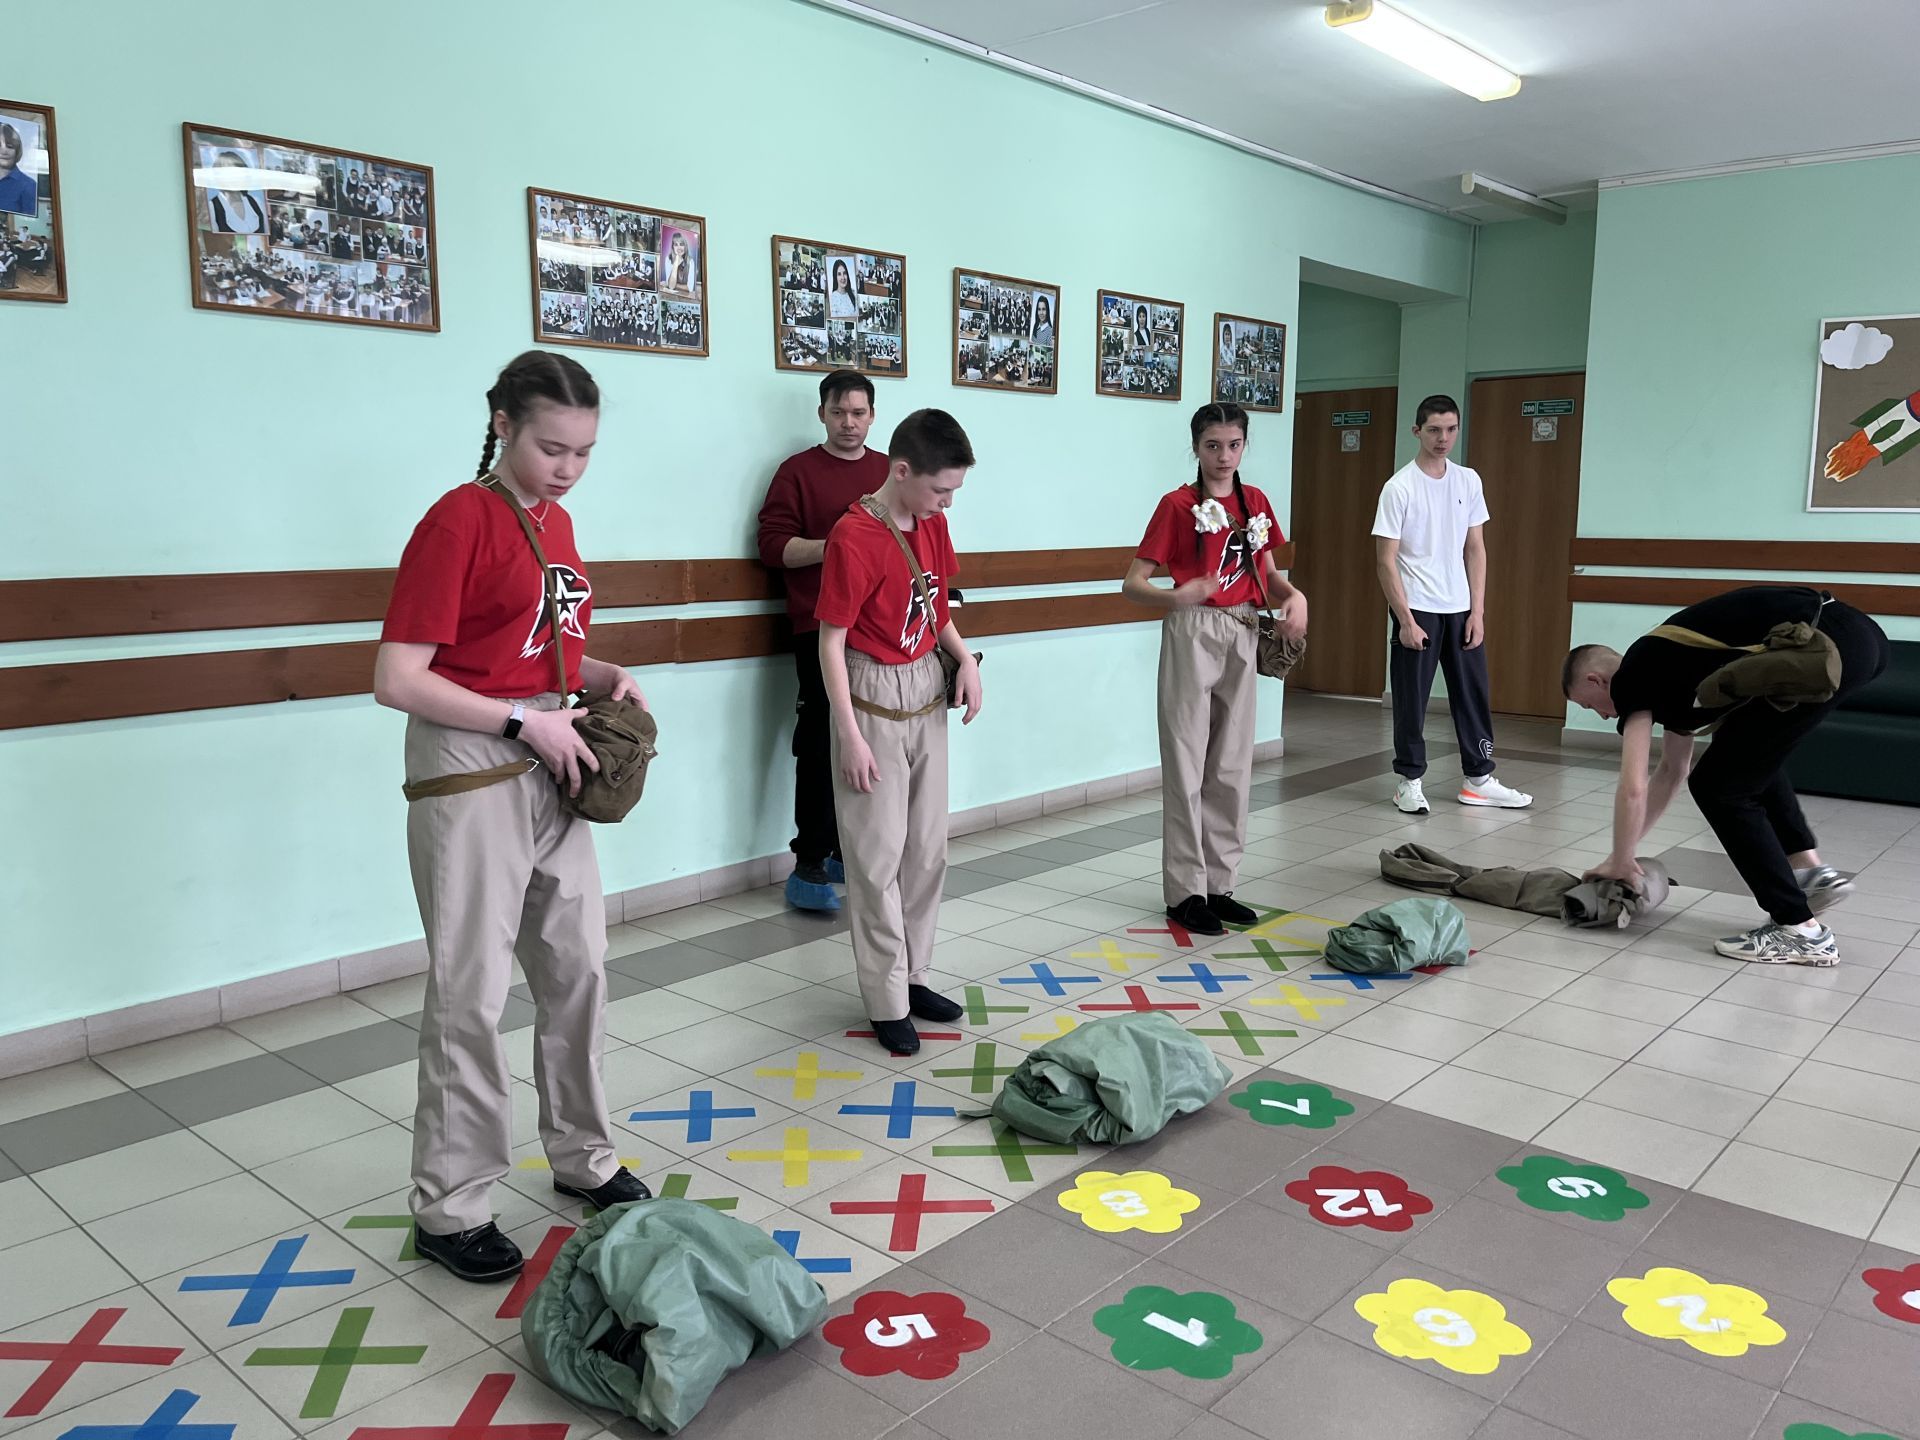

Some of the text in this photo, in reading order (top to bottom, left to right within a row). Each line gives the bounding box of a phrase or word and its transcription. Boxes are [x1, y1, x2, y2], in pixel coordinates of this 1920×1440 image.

[1260, 1097, 1311, 1116] 7
[1098, 1189, 1150, 1219] 8
[1315, 1189, 1403, 1219] 12
[1143, 1311, 1210, 1348] 1
[1656, 1294, 1733, 1333] 2
[864, 1313, 937, 1348] 5
